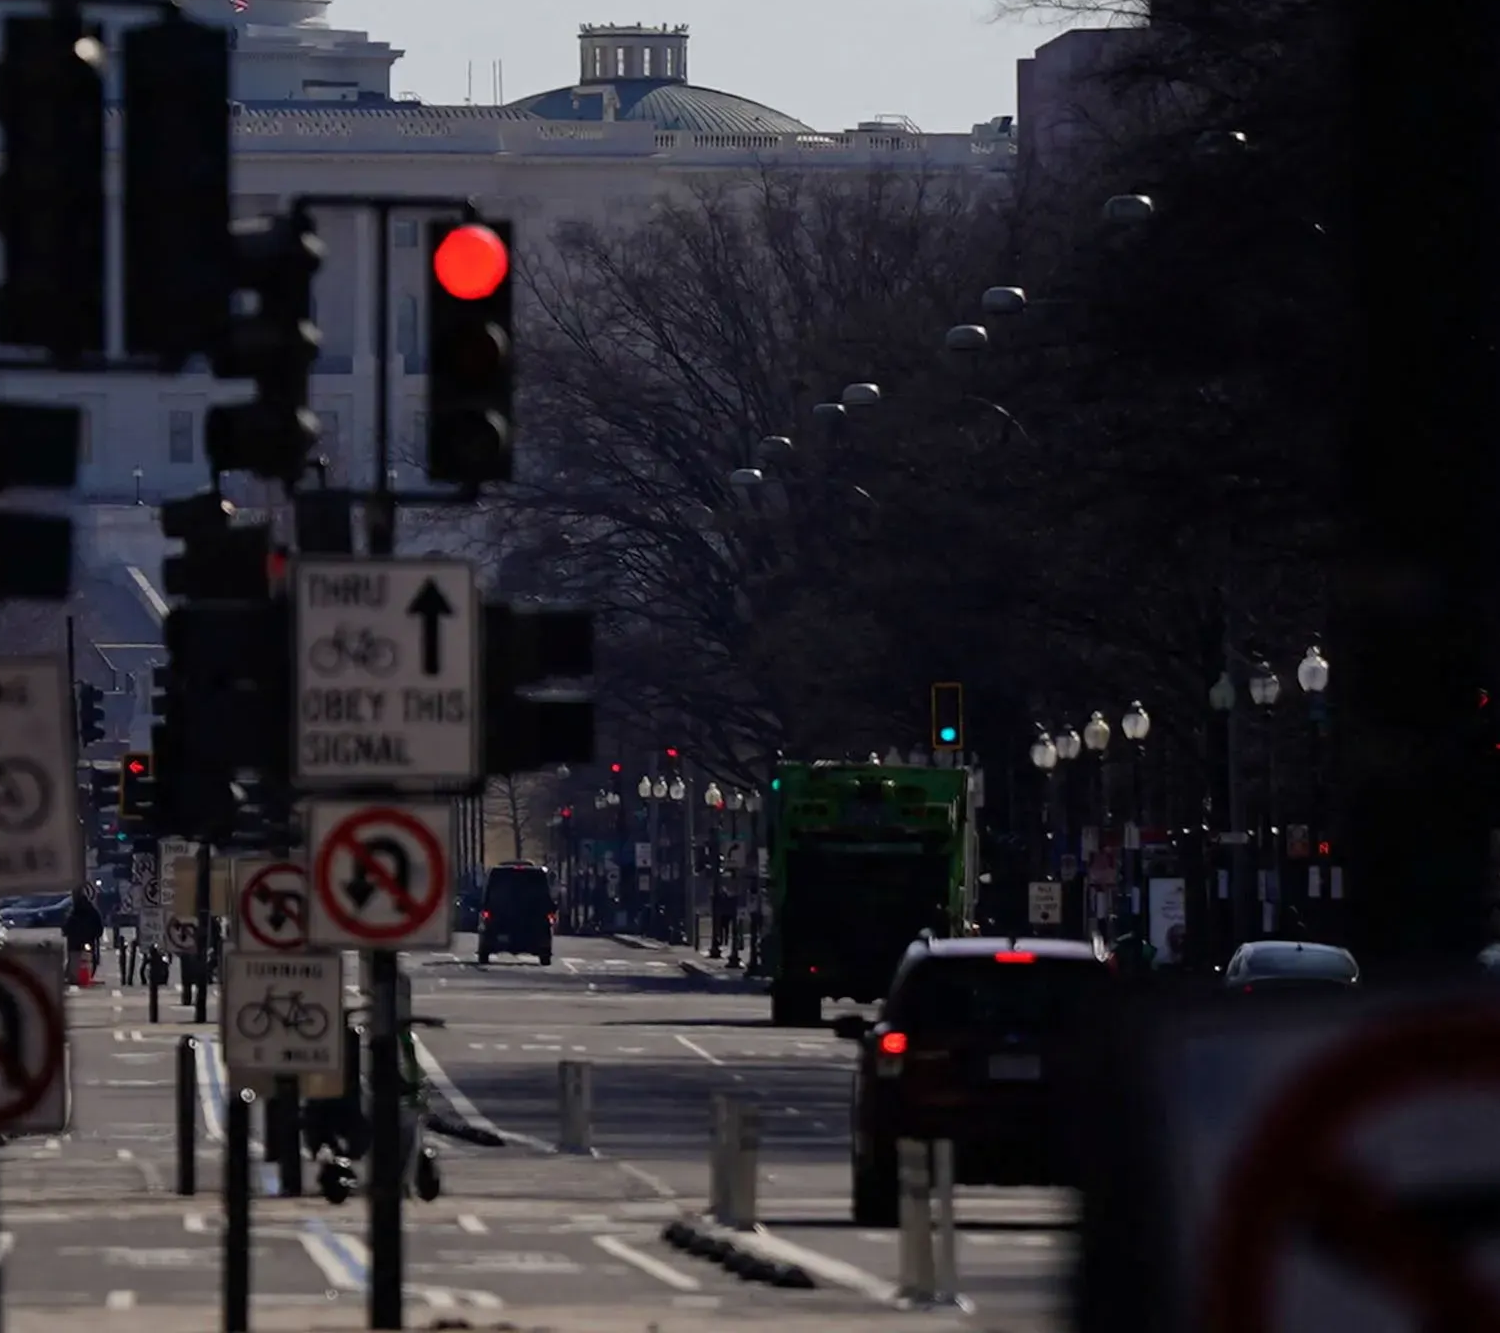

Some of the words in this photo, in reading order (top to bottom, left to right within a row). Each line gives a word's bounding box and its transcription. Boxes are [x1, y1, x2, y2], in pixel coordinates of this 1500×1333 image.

[308, 573, 388, 610] THRU
[302, 689, 382, 724] OBEY
[403, 689, 464, 724] THIS
[303, 732, 412, 765] SIGNAL
[246, 961, 323, 978] TURNING
